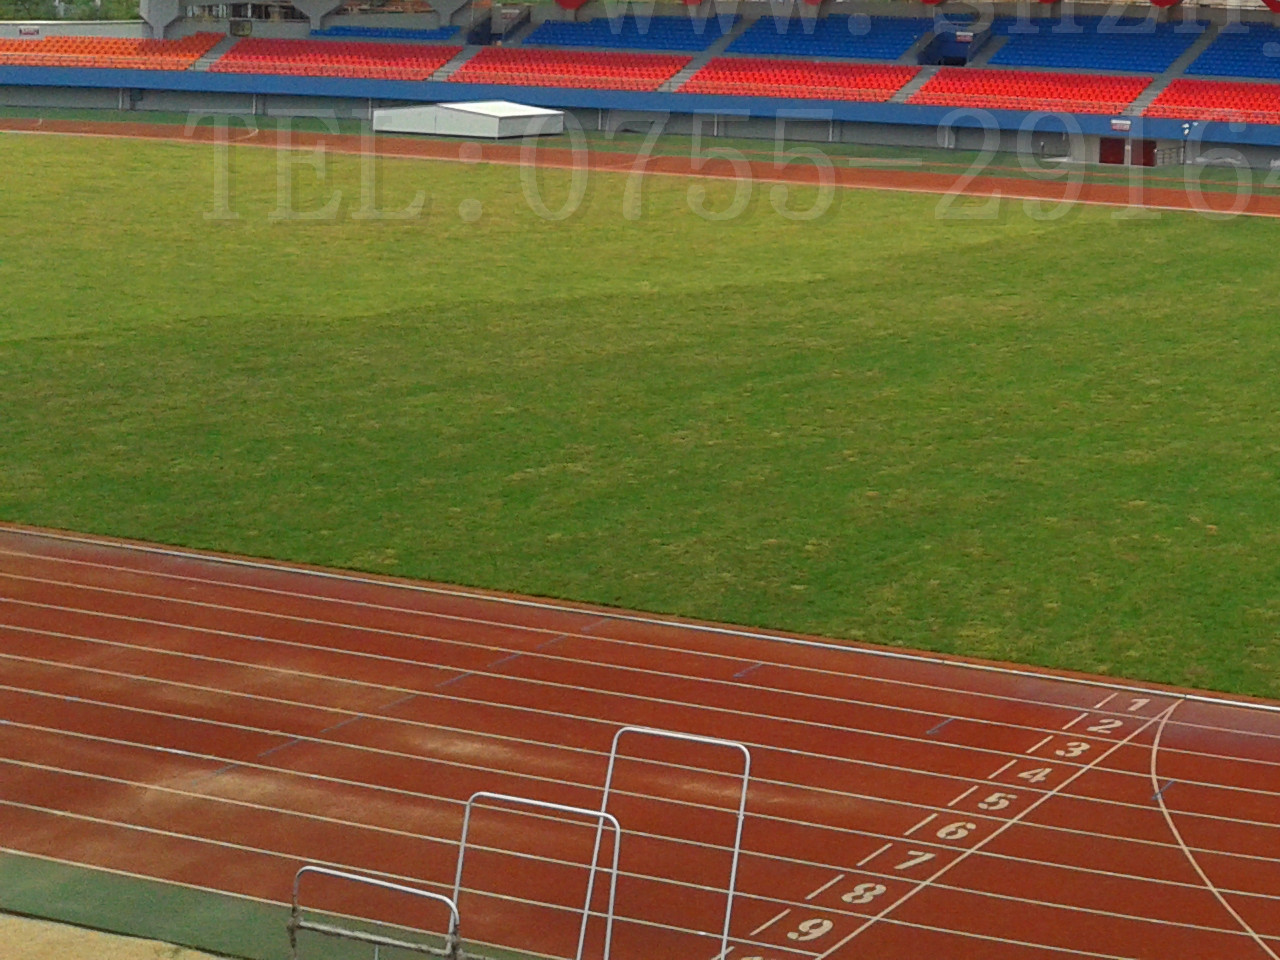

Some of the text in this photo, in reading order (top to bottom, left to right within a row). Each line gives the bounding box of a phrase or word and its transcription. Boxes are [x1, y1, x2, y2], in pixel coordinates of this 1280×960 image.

[1127, 698, 1150, 712] 1
[1086, 718, 1124, 734] 2
[1055, 741, 1091, 758] 3
[1016, 767, 1053, 783] 4
[977, 792, 1018, 811] 5
[936, 821, 976, 840] 6
[894, 850, 937, 870] 7
[841, 882, 886, 904] 8
[787, 918, 834, 941] 9
